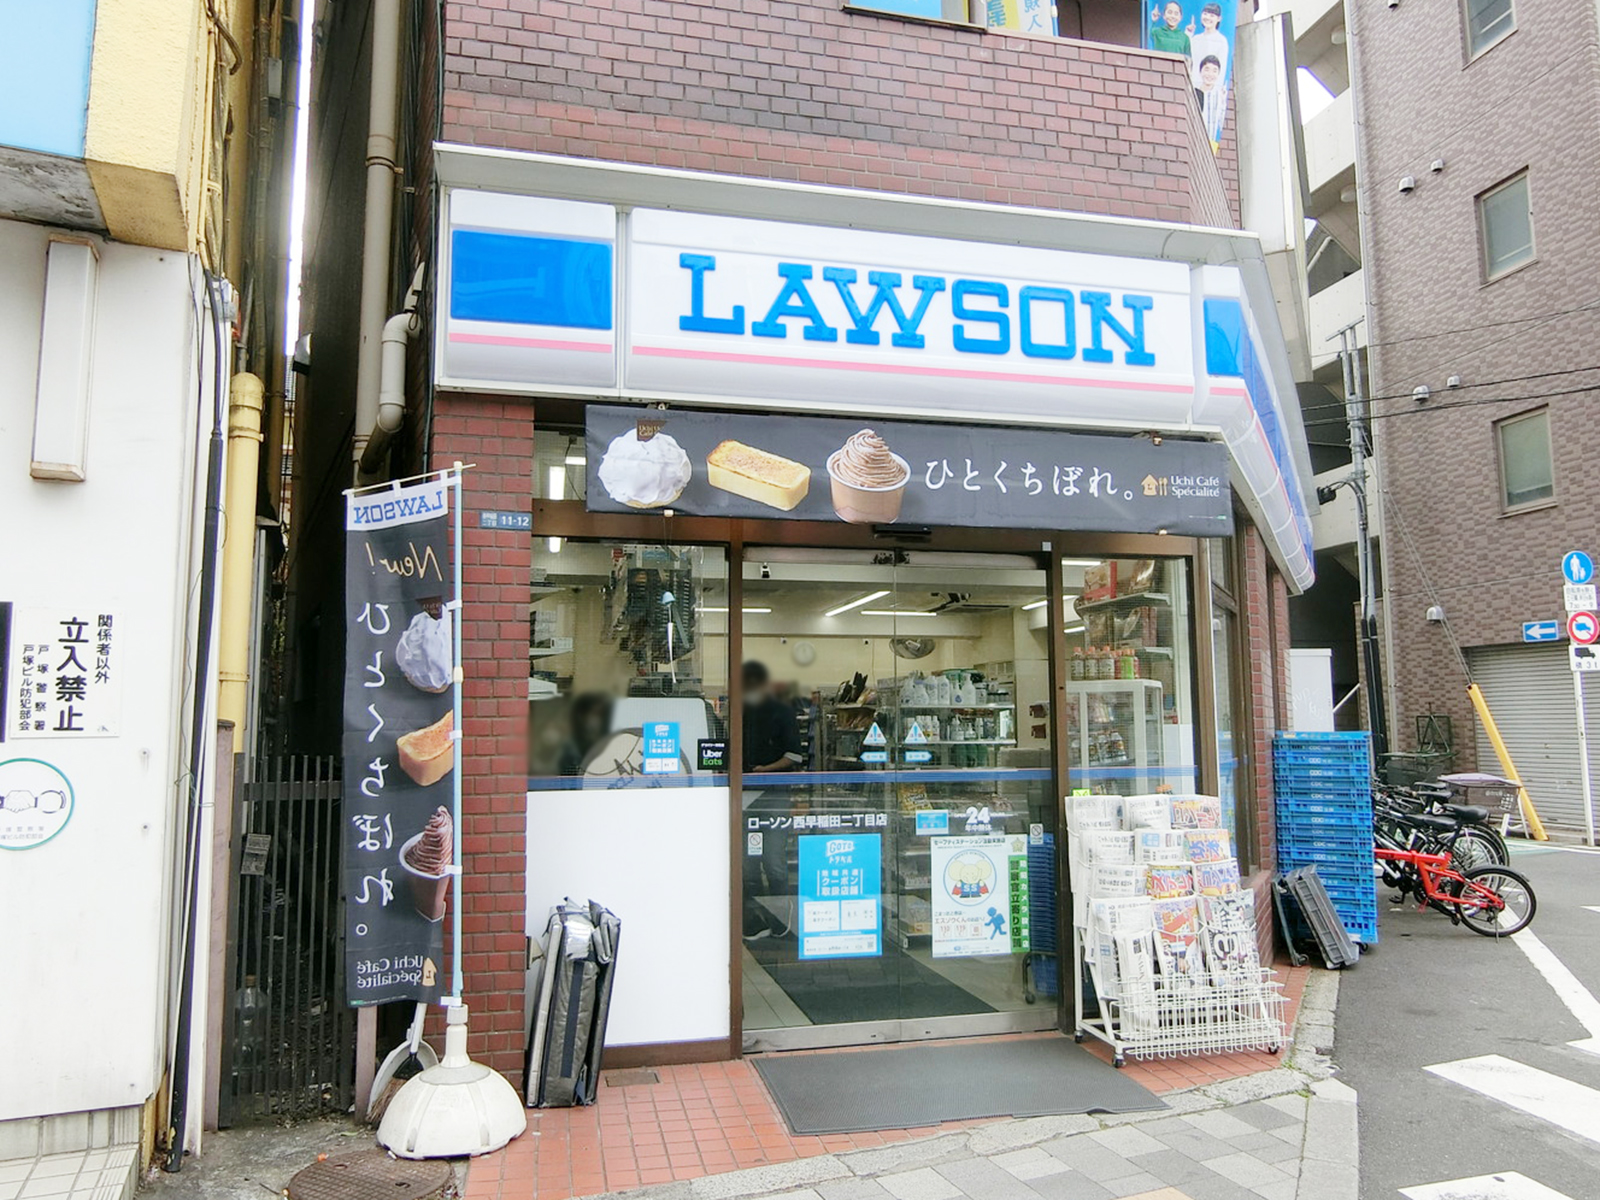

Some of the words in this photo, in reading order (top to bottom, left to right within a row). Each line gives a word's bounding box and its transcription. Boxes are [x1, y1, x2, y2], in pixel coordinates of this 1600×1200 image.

[679, 252, 1155, 367] LAWSON
[925, 458, 1133, 501] ひとくちぼれ。
[1171, 475, 1193, 486] Uchi
[1196, 476, 1219, 486] Café
[1172, 486, 1220, 499] Spécialité
[502, 515, 529, 527] 11-12
[94, 614, 113, 684] 関係者以外
[52, 616, 90, 732] 立入禁止
[18, 644, 35, 731] 戸塚ビル防犯部会
[34, 645, 50, 731] 戸塚警察署
[702, 749, 723, 758] Uber
[703, 758, 723, 766] Eats
[747, 813, 888, 829] ローソン西早稲田二丁目店
[965, 806, 991, 824] 24
[821, 877, 859, 886] クーポン
